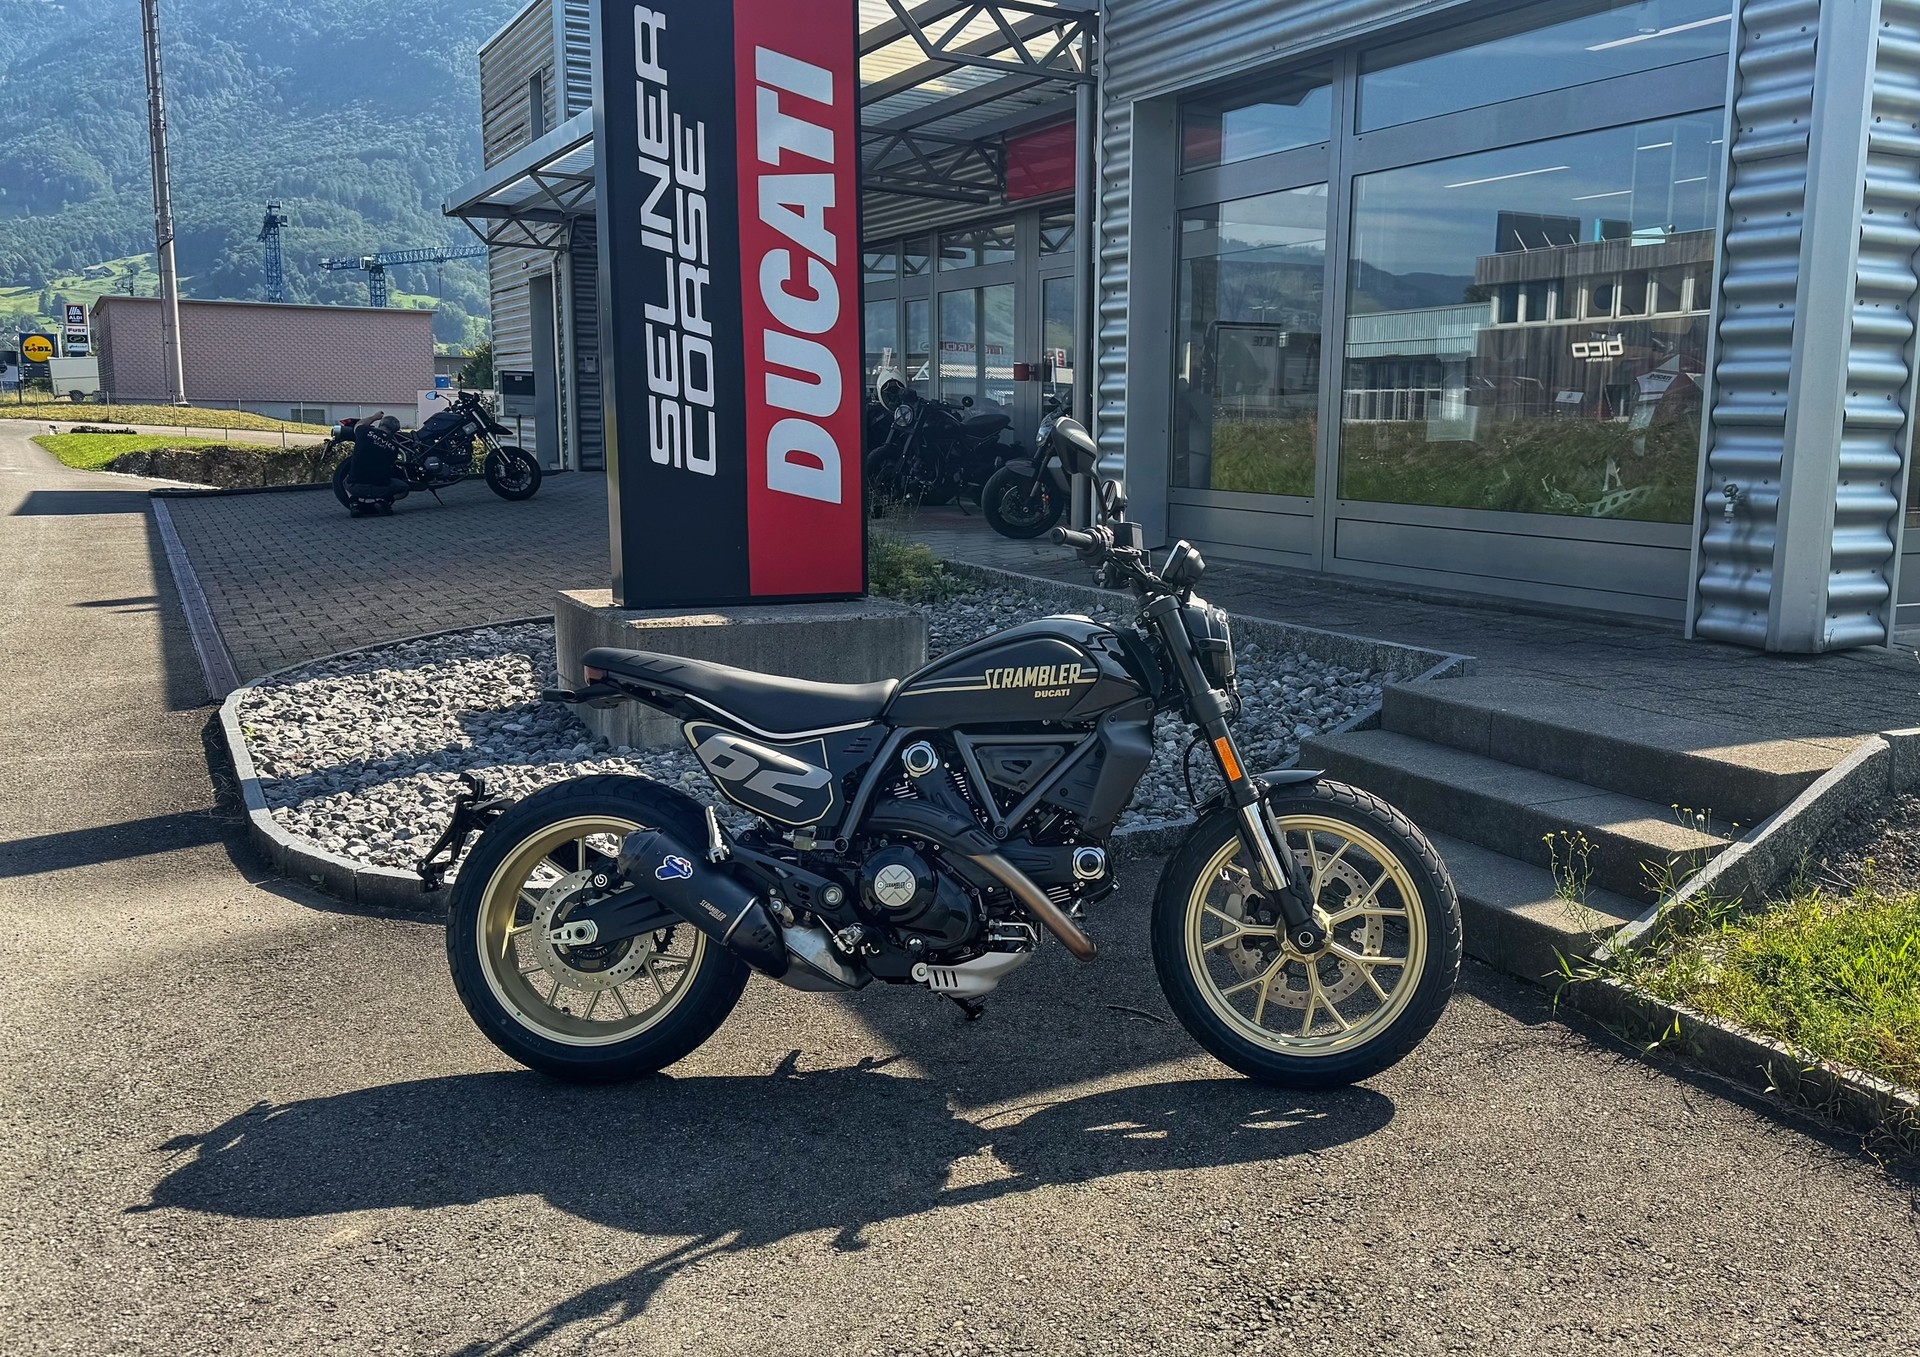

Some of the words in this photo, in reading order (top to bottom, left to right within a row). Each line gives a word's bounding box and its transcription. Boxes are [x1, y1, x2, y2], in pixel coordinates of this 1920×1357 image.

[634, 4, 682, 469] SELINER
[755, 45, 842, 504] DUCATI
[673, 112, 717, 477] CORSE
[367, 430, 396, 450] Service
[984, 663, 1082, 690] SCRAMBLER
[1034, 688, 1071, 698] DUCATI
[695, 732, 833, 808] 62
